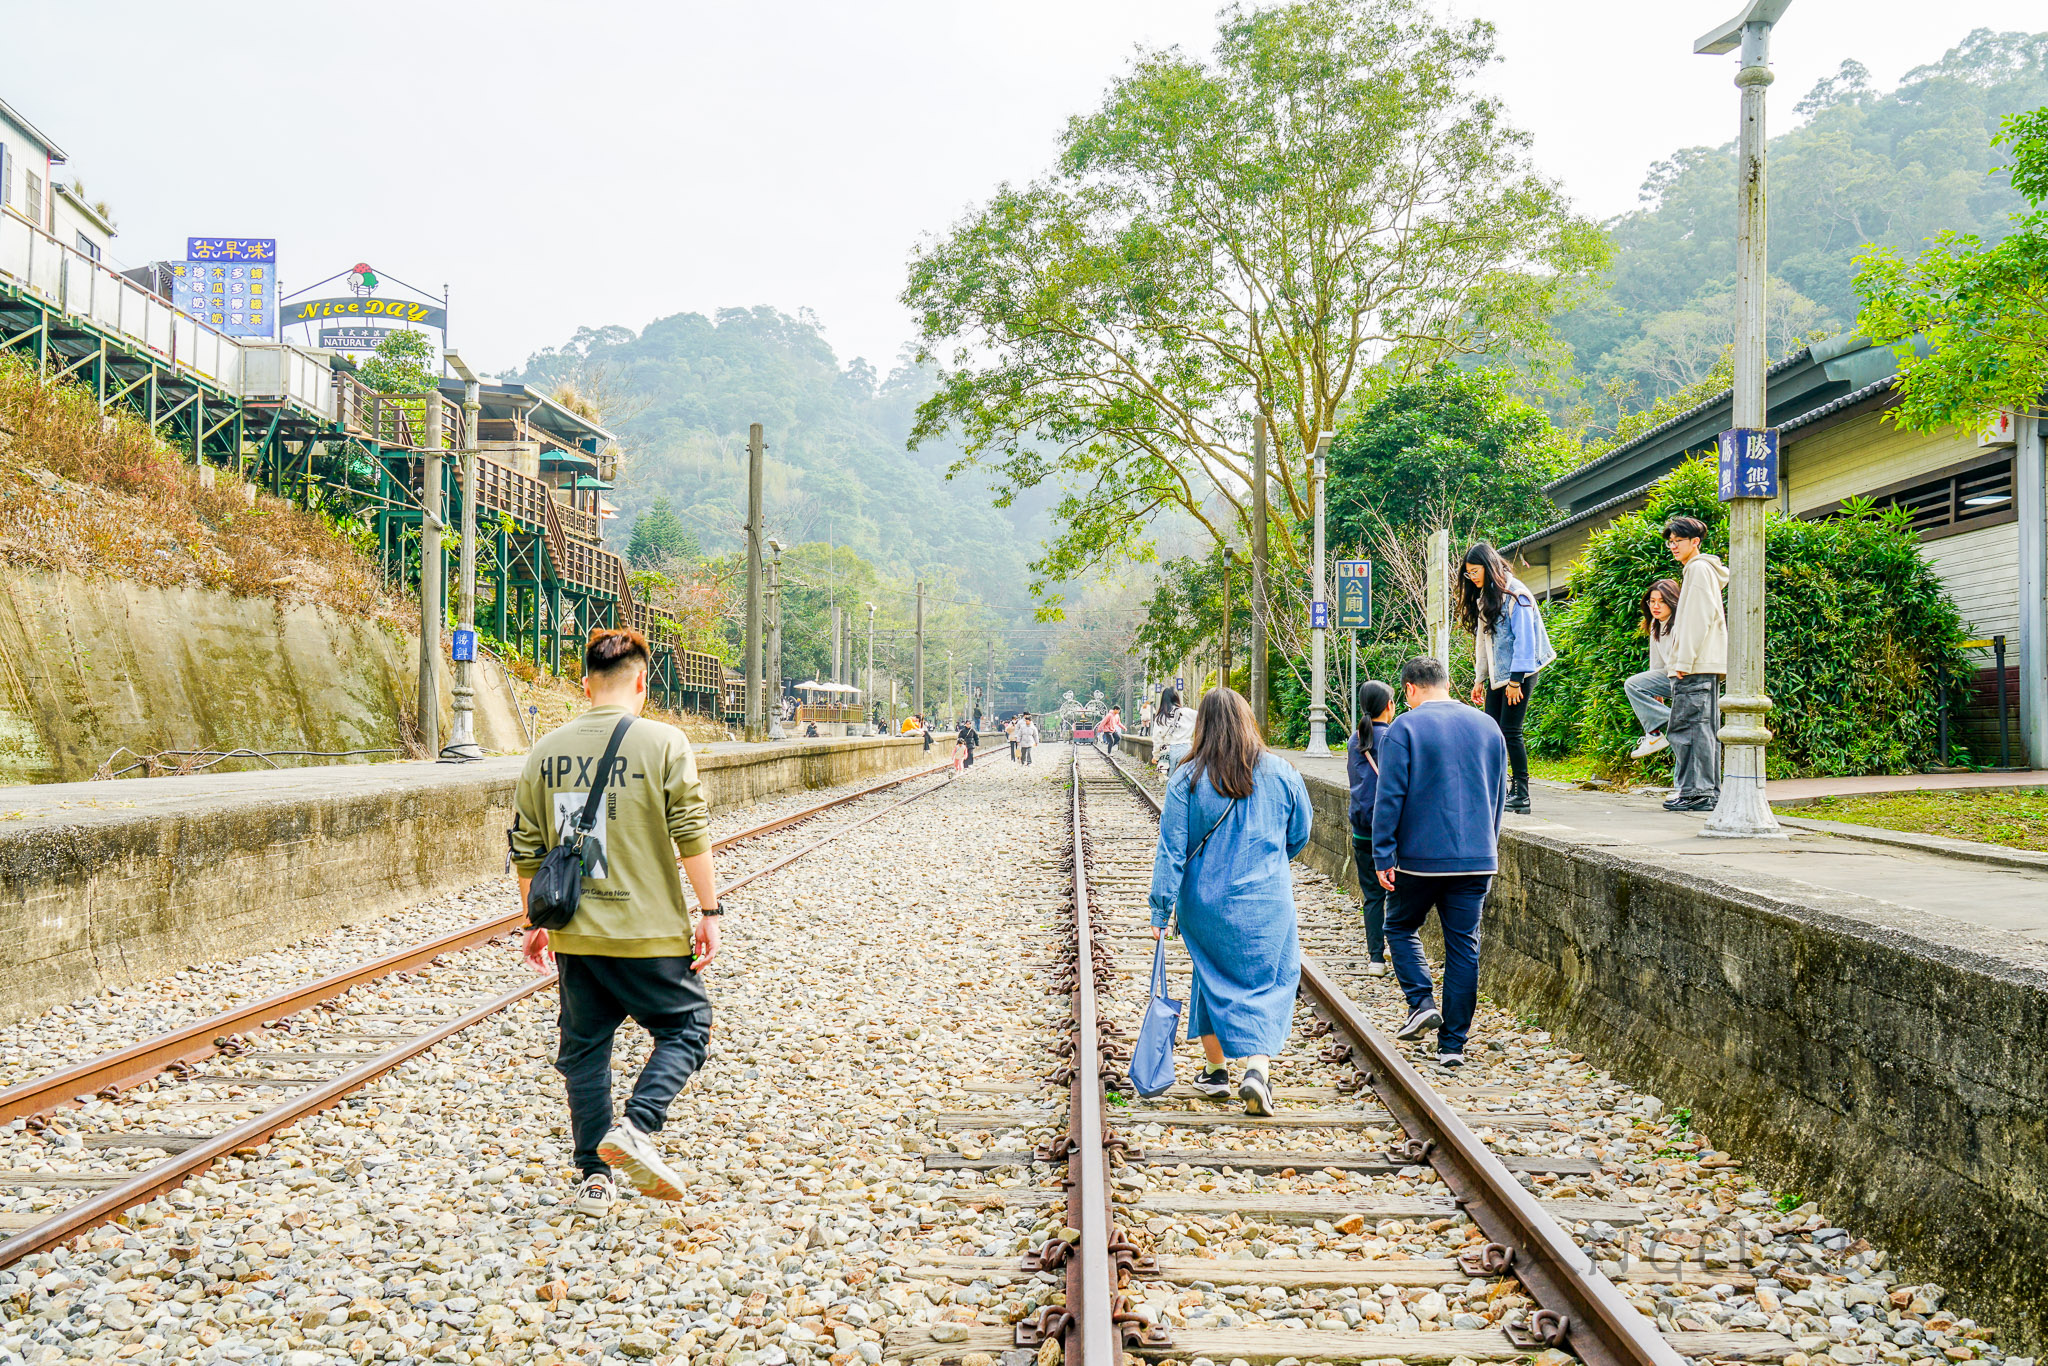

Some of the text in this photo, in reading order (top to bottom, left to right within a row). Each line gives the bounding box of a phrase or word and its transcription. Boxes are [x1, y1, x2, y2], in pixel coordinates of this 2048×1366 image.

[195, 240, 268, 260] 古早味
[211, 266, 225, 325] 木瓜牛奶
[249, 268, 264, 325] 蜂蜜綠茶
[298, 302, 359, 319] Nice
[324, 338, 367, 347] NATURAL
[1745, 434, 1772, 492] 勝興
[1346, 580, 1362, 612] 公廁
[608, 792, 617, 821] SITEMAP
[614, 889, 631, 897] Now
